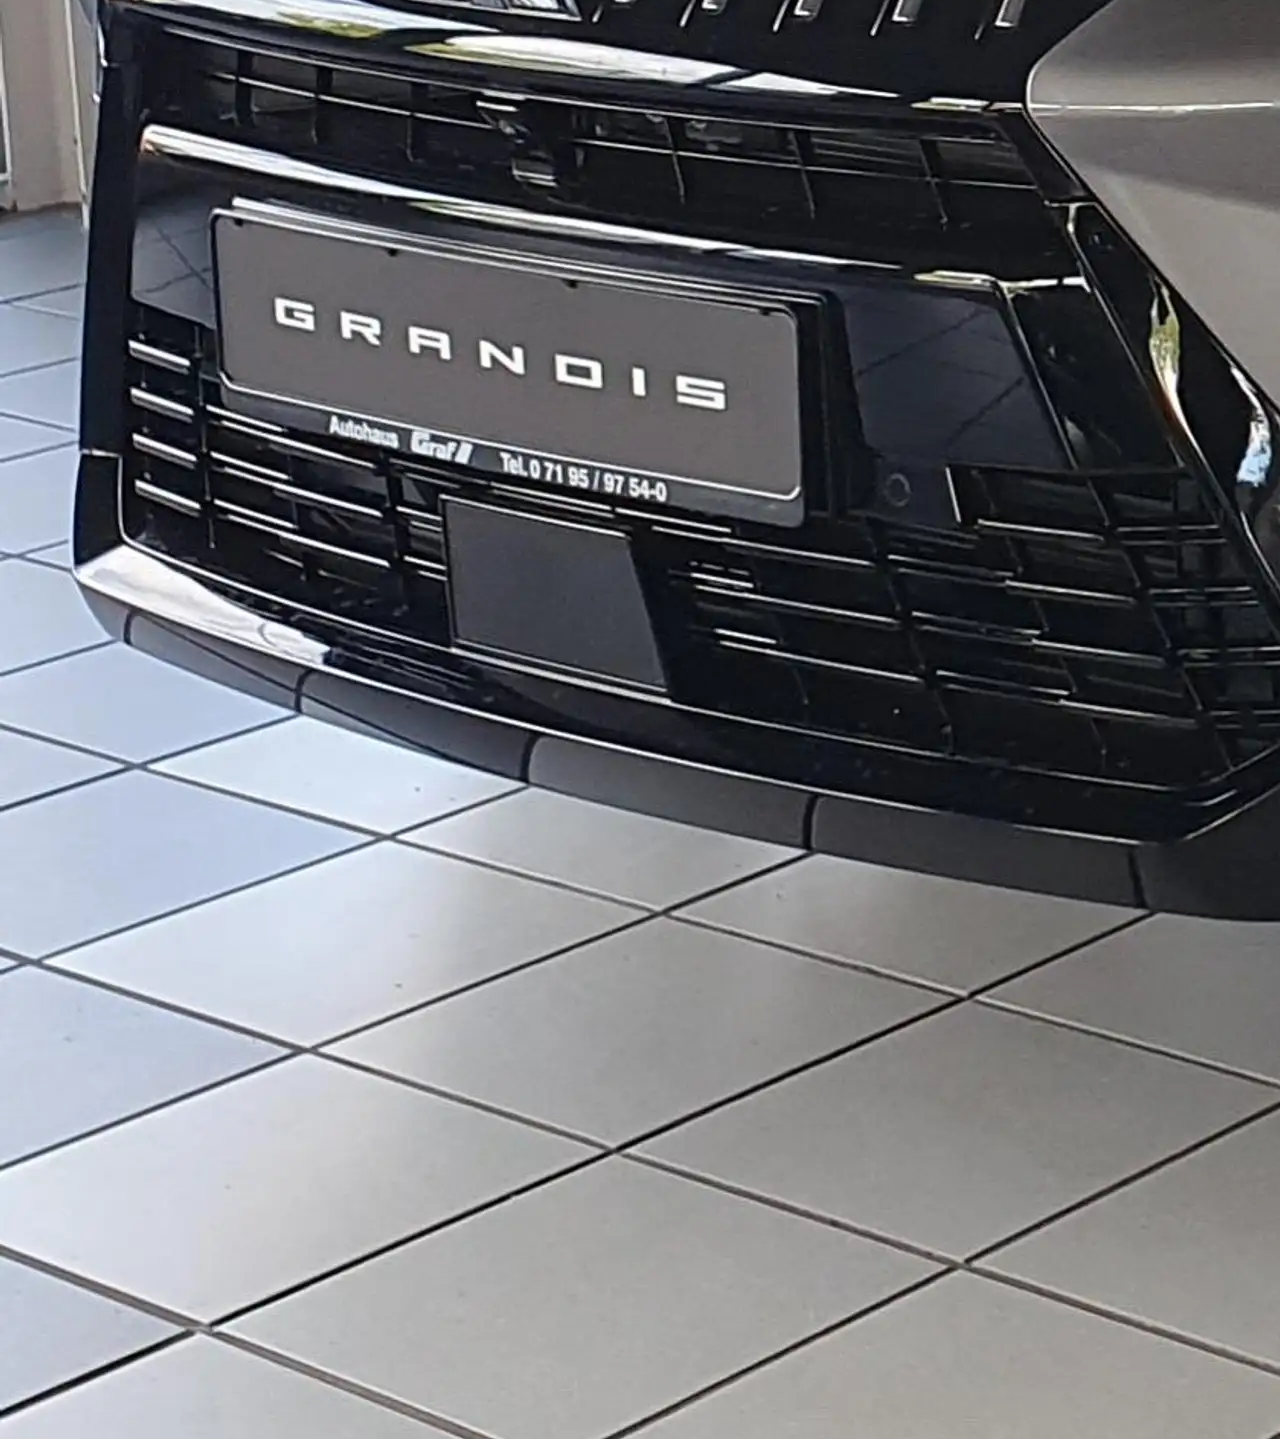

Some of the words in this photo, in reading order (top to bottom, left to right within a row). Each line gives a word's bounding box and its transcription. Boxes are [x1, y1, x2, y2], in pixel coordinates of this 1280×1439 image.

[273, 297, 728, 410] GRANDIS
[329, 414, 400, 450] Autohaus
[499, 451, 528, 477] Tel.
[529, 459, 541, 479] 0
[543, 463, 564, 485] 71
[567, 465, 590, 490] 95
[603, 472, 626, 496] 97
[628, 477, 668, 503] 54-0
